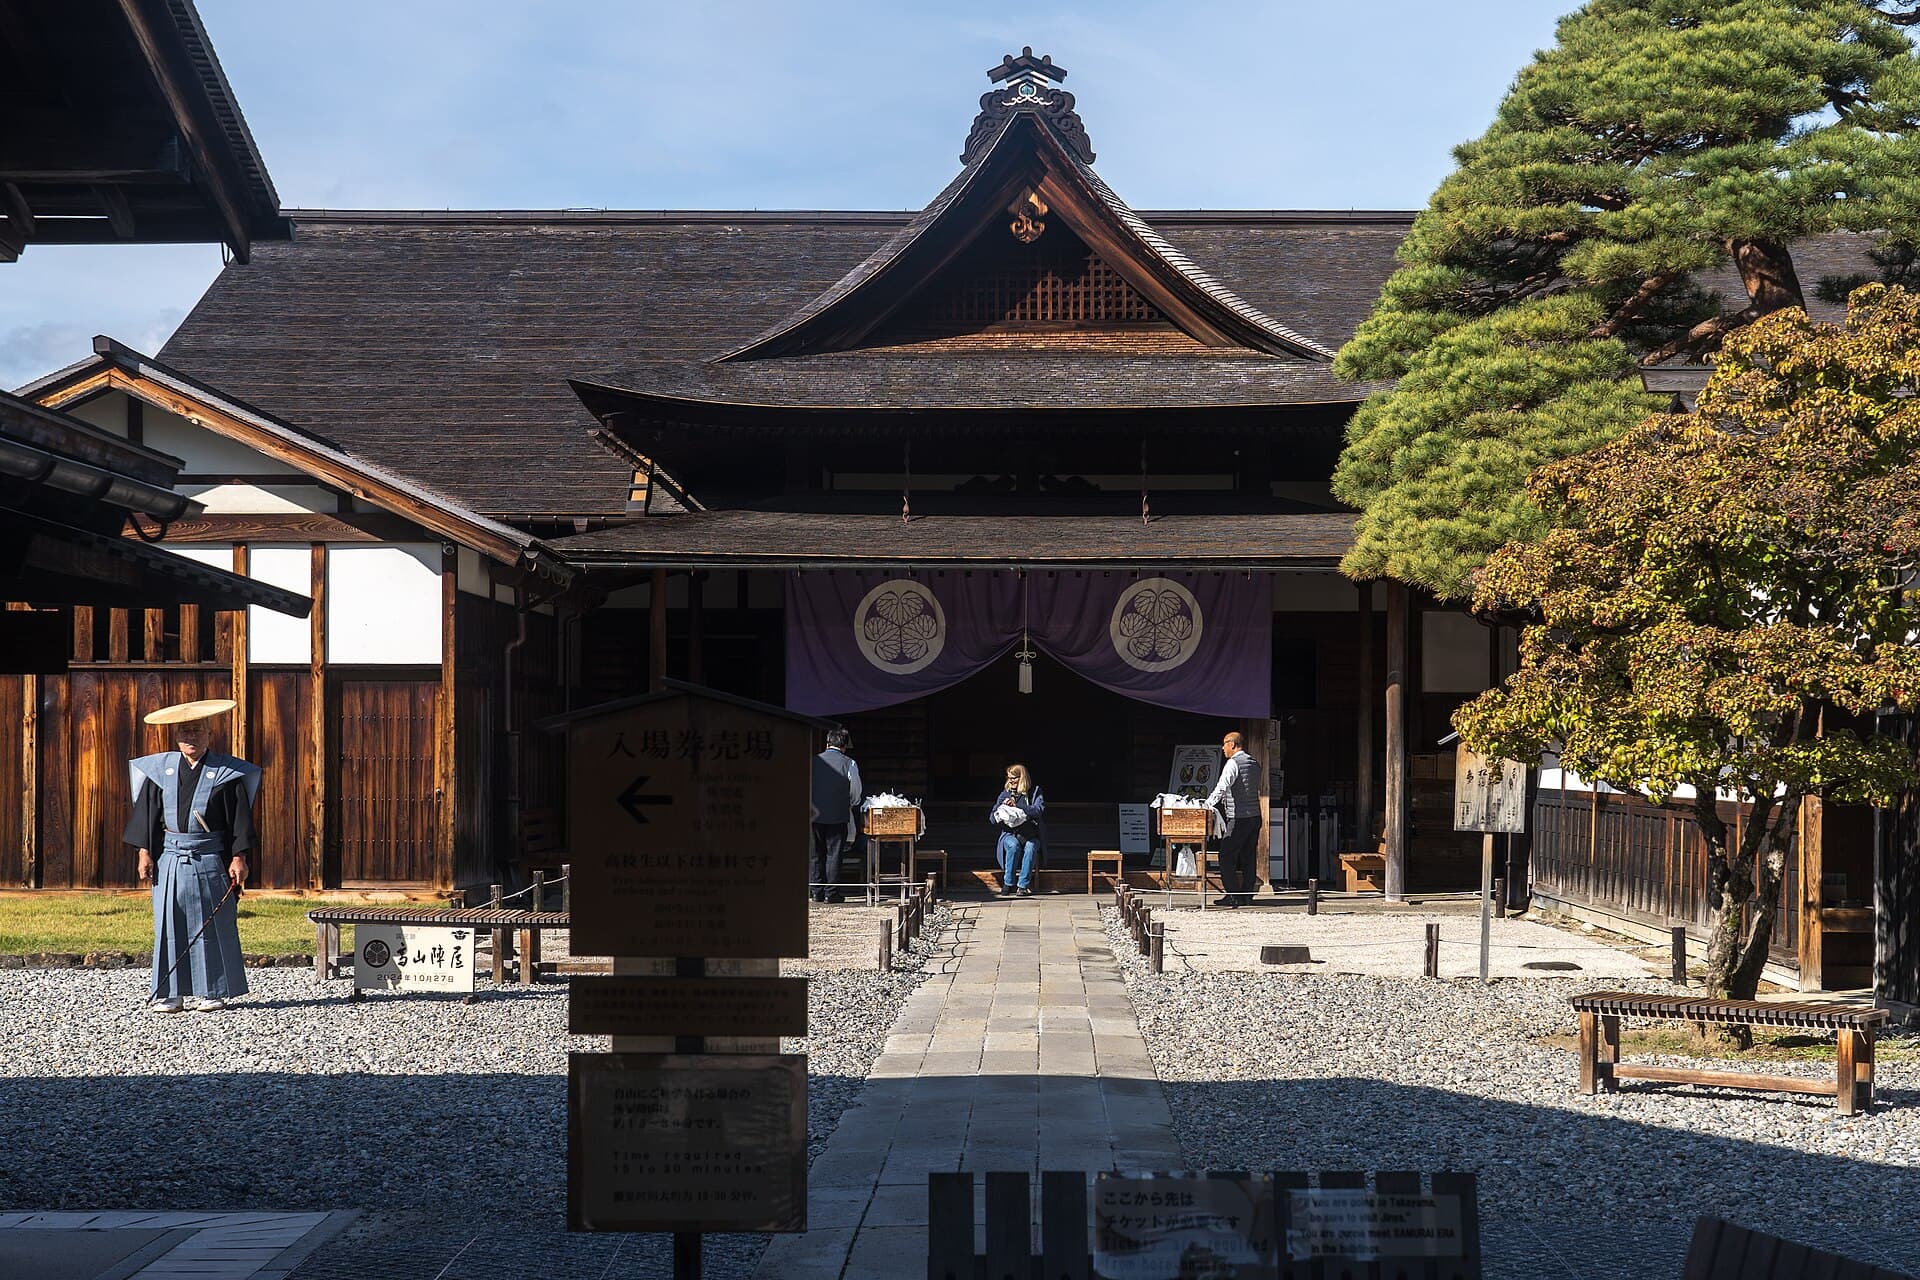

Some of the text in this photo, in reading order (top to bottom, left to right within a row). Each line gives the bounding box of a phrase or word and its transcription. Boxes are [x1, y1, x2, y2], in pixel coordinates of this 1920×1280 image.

[606, 729, 775, 760] 入場券売場
[397, 942, 464, 968] 高山陣屋
[377, 974, 454, 983] 2024年10月27日
[613, 1151, 742, 1162] Time required
[613, 1164, 630, 1174] 15
[639, 1164, 656, 1174] to
[1104, 1191, 1195, 1206] ここから先は
[1437, 1228, 1456, 1239] ERA
